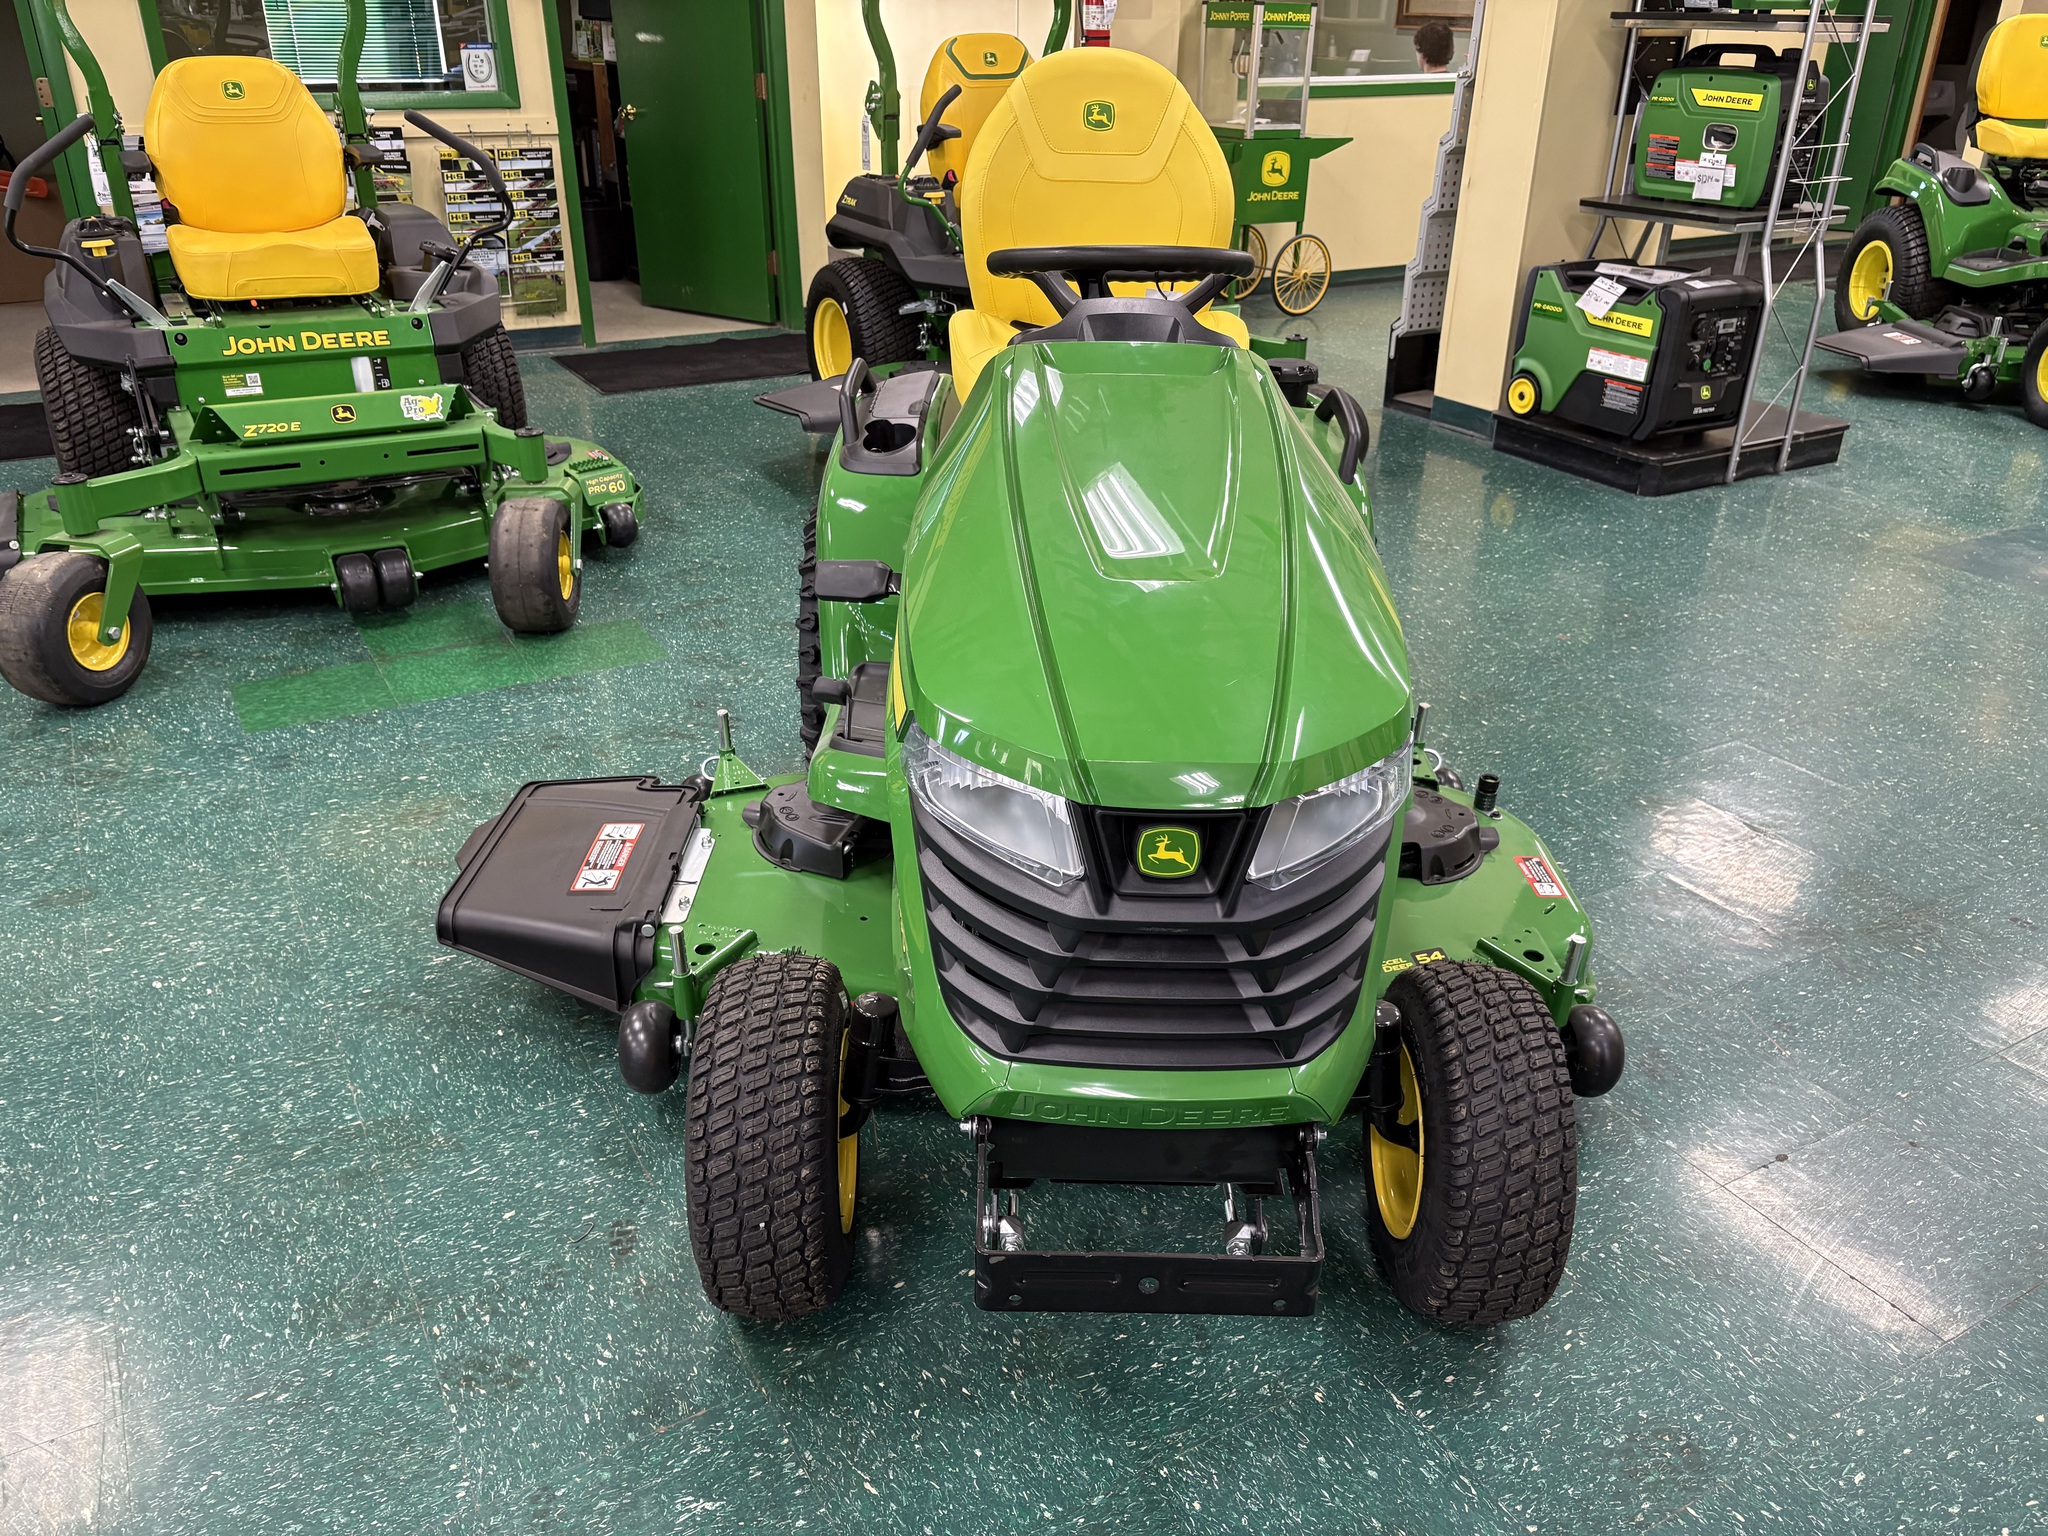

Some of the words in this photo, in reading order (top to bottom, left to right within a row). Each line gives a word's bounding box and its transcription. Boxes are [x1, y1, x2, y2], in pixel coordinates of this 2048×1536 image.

[1209, 10, 1229, 22] JOHNNY
[1230, 11, 1250, 22] POPPER
[1263, 10, 1287, 22] JOHNNY
[1287, 11, 1311, 22] POPPER
[1702, 94, 1725, 104] JOHN
[1725, 95, 1753, 106] DEERE
[1247, 190, 1271, 202] JOHN
[1271, 190, 1300, 201] DEERE
[1615, 316, 1644, 330] DEERE
[222, 334, 297, 357] JOHN
[300, 329, 391, 352] DEERE
[404, 397, 422, 407] Ag-
[406, 406, 425, 415] Pro
[243, 424, 289, 438] Z720
[290, 421, 302, 432] E
[586, 478, 599, 486] High
[599, 473, 624, 482] Capacity
[588, 485, 607, 495] PRO
[608, 480, 626, 494] 60
[1415, 950, 1446, 965] 54
[1382, 962, 1414, 973] DEEP
[1009, 1094, 1131, 1126] JOHN
[1141, 1103, 1292, 1127] DEERE
